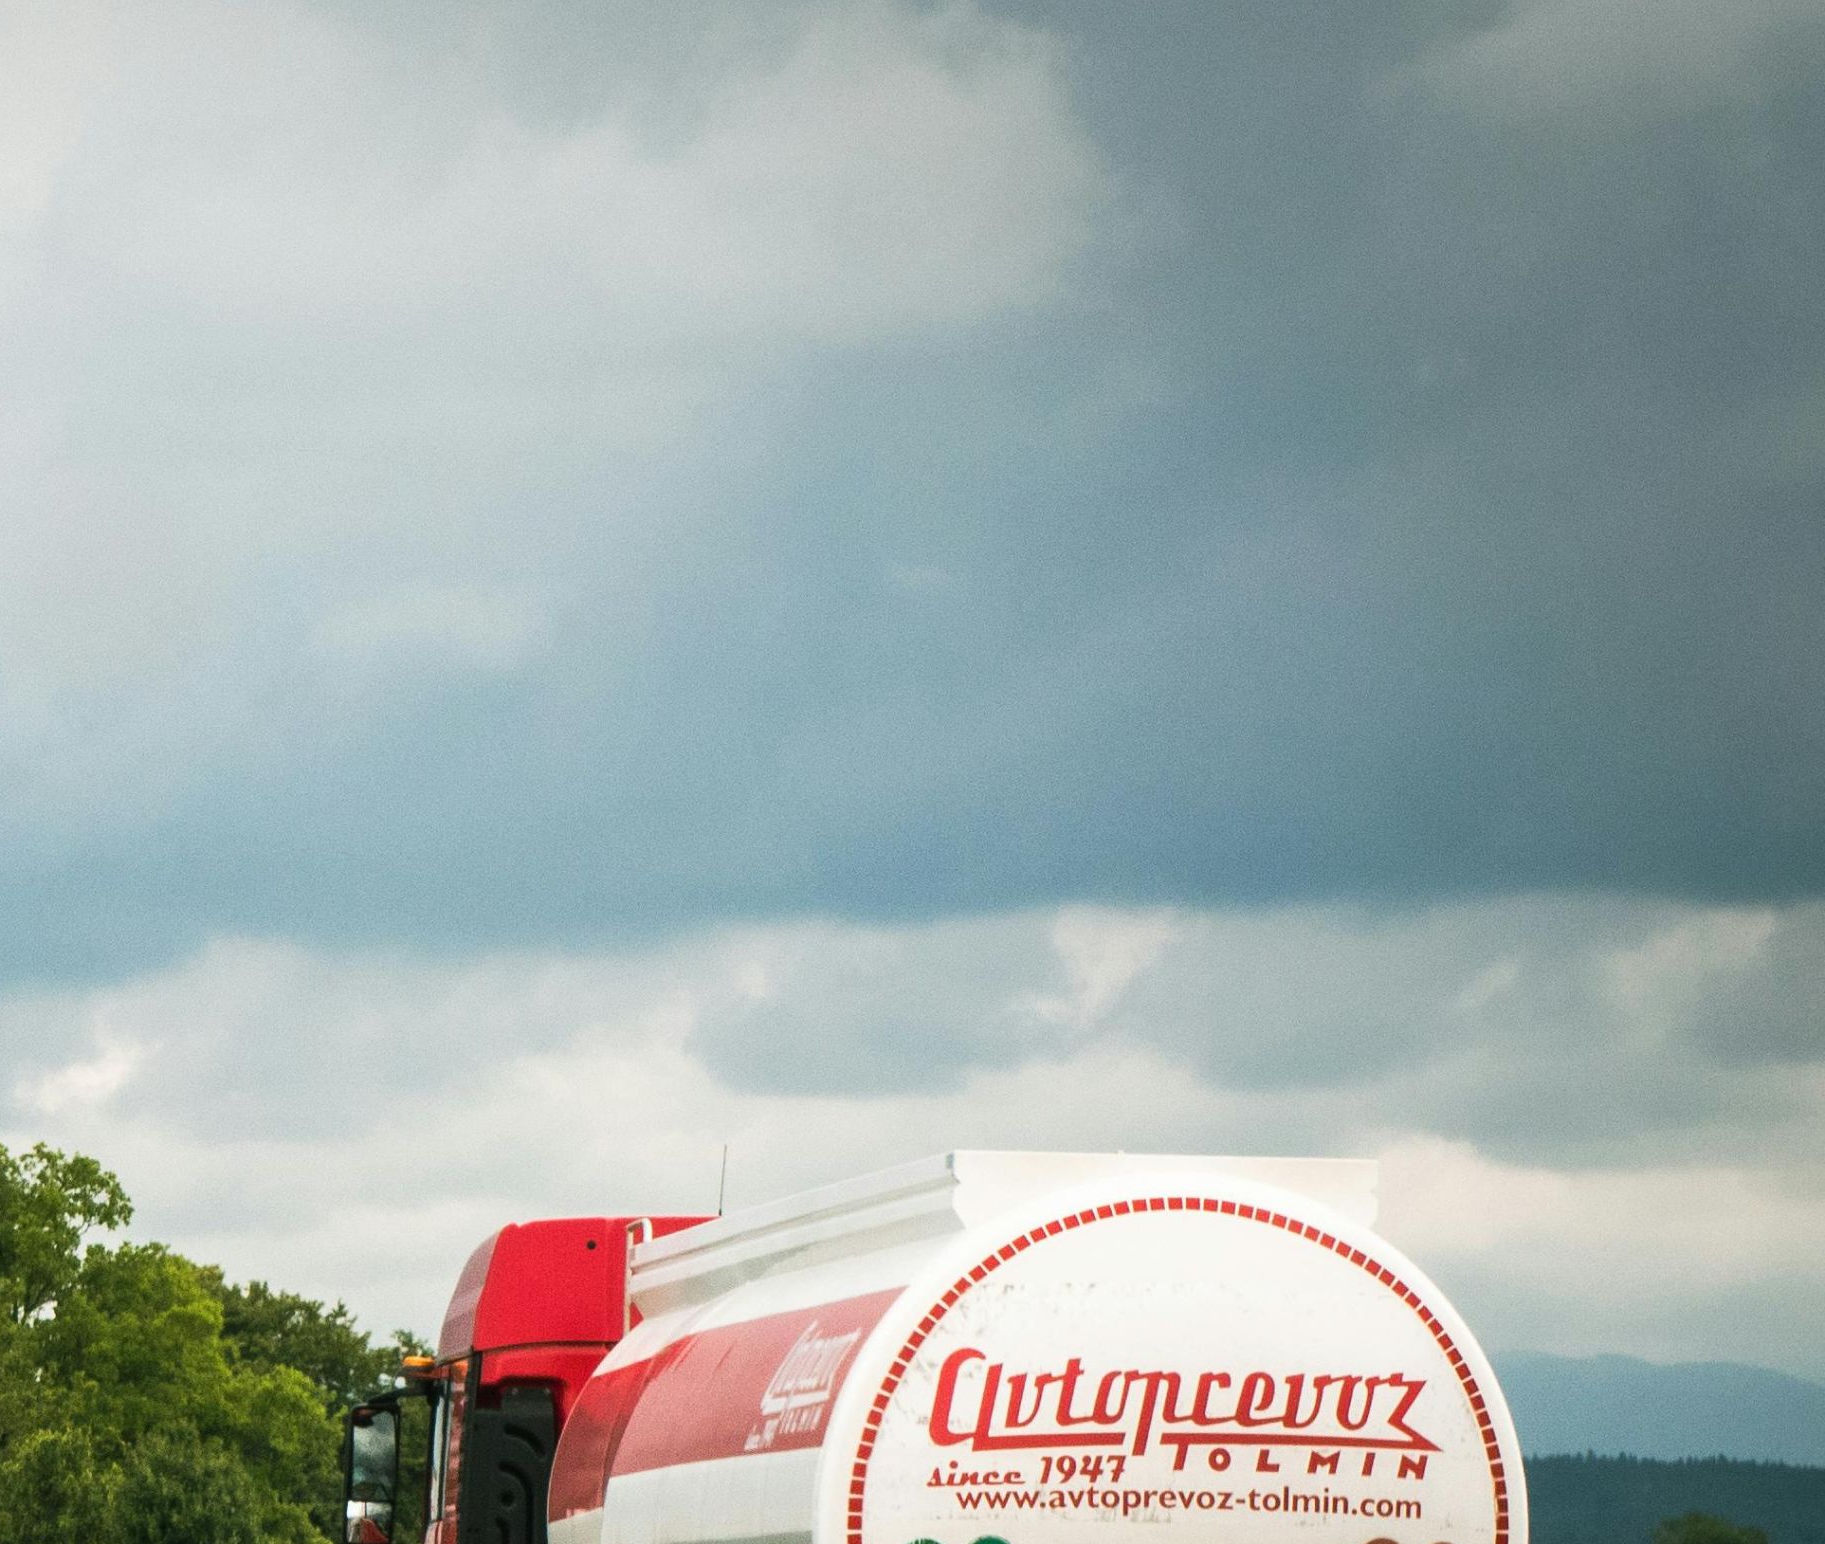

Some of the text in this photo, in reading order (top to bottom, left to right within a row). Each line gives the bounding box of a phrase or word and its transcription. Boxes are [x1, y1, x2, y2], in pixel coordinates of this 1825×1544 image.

[926, 1455, 1128, 1487] since 1947
[1171, 1446, 1429, 1481] TOLMIN
[956, 1484, 1423, 1520] www.avtoprevoz-tolmin.com
